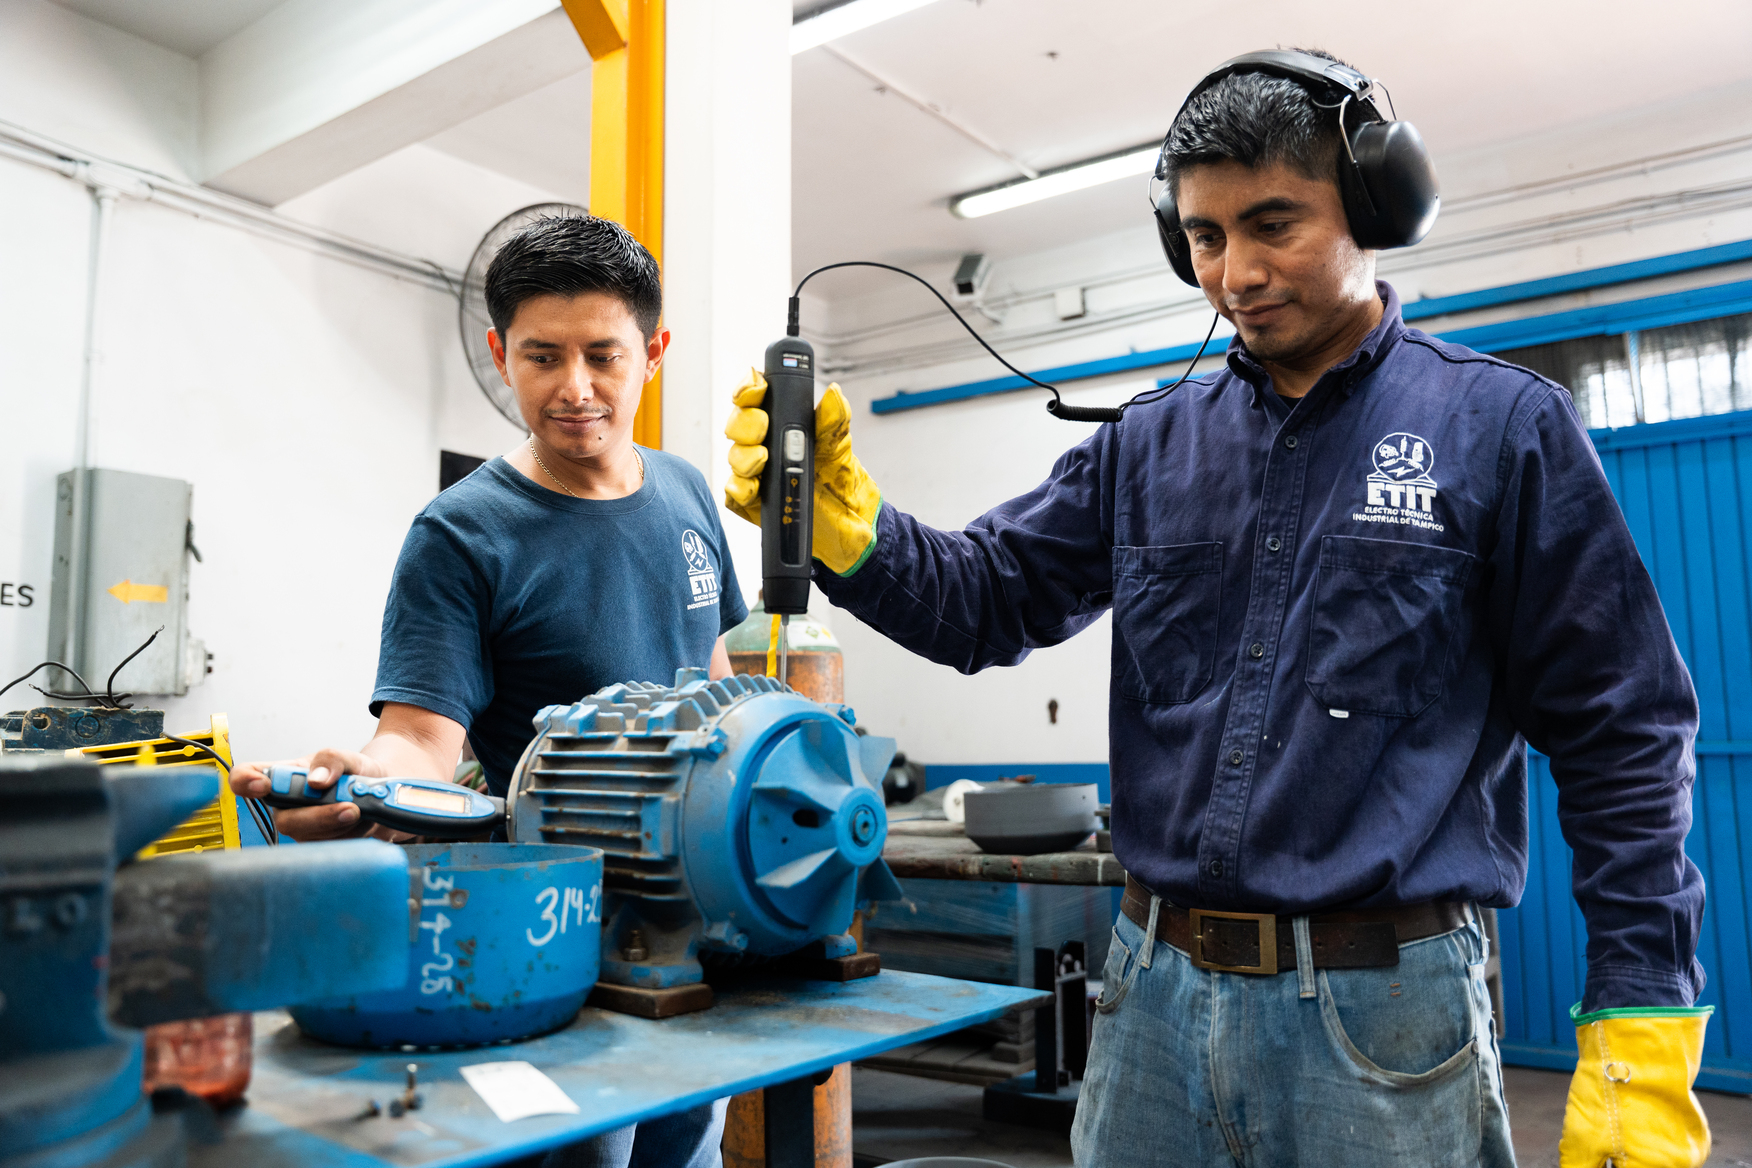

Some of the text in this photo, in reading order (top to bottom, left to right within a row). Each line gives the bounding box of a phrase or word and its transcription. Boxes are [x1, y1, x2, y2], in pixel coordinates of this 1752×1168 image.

[1367, 482, 1437, 512] ETIT
[1364, 507, 1398, 515] ELECTRO
[1352, 513, 1399, 524] INDUSTRIAL
[1411, 519, 1444, 532] TAMPICO
[1, 583, 35, 607] ES
